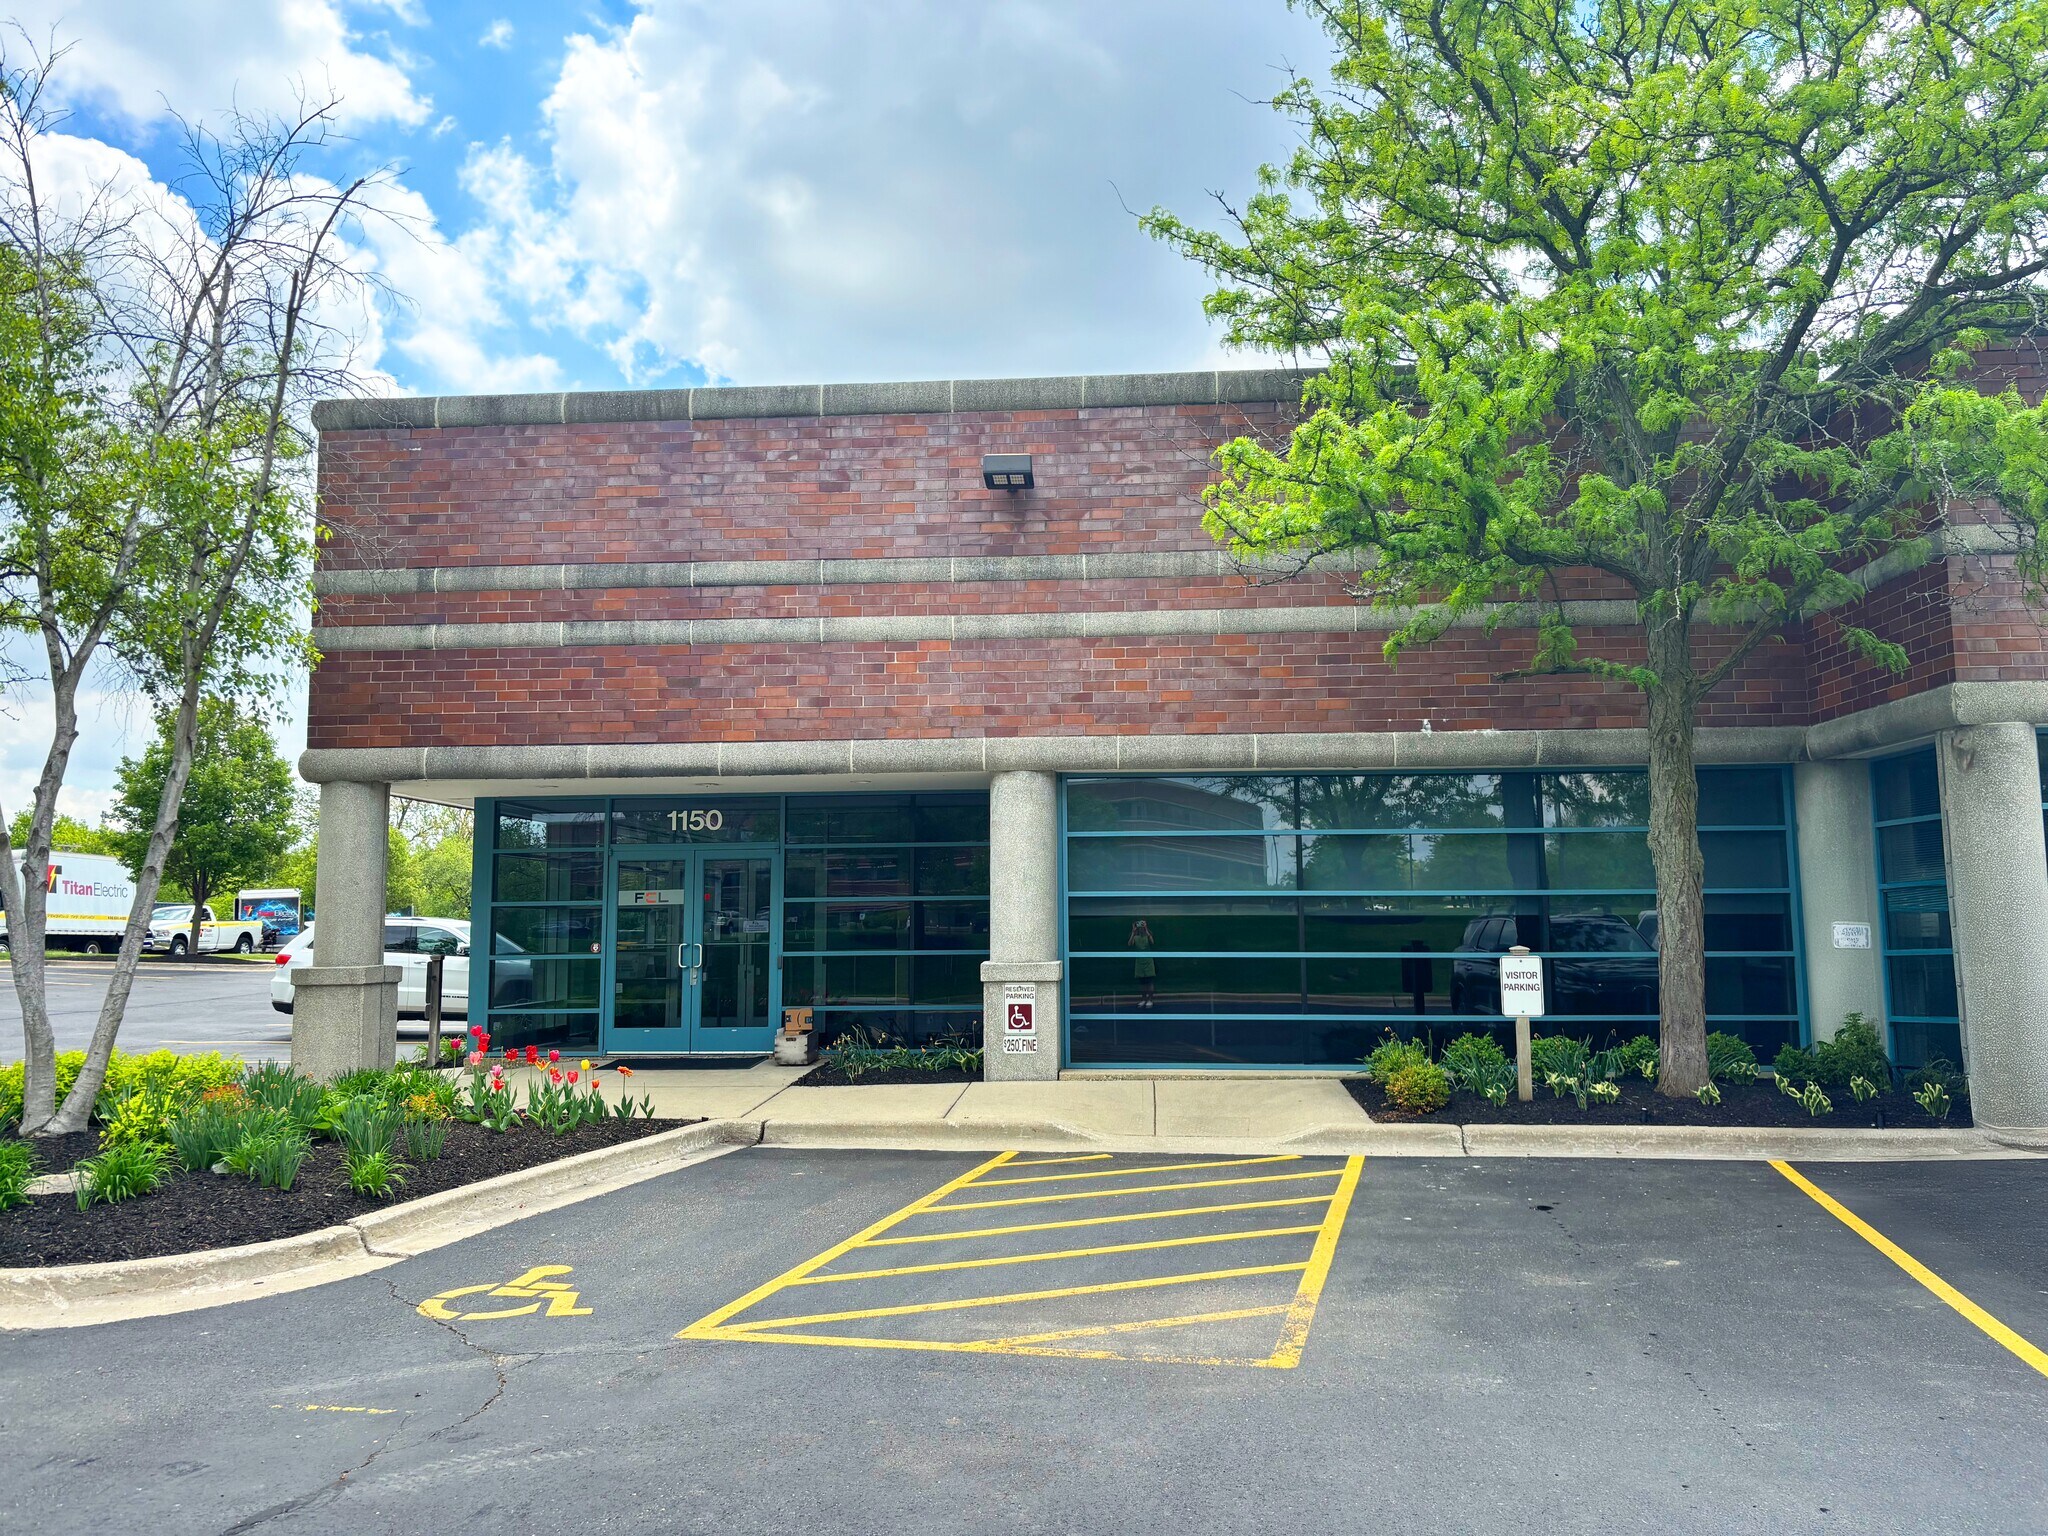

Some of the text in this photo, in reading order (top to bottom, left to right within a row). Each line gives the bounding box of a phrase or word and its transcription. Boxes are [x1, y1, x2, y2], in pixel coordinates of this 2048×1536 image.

[667, 809, 723, 831] 1150
[635, 892, 669, 904] FCL
[1505, 971, 1538, 980] VISITOR
[1503, 983, 1541, 992] PARKING
[1021, 1039, 1037, 1052] FINE
